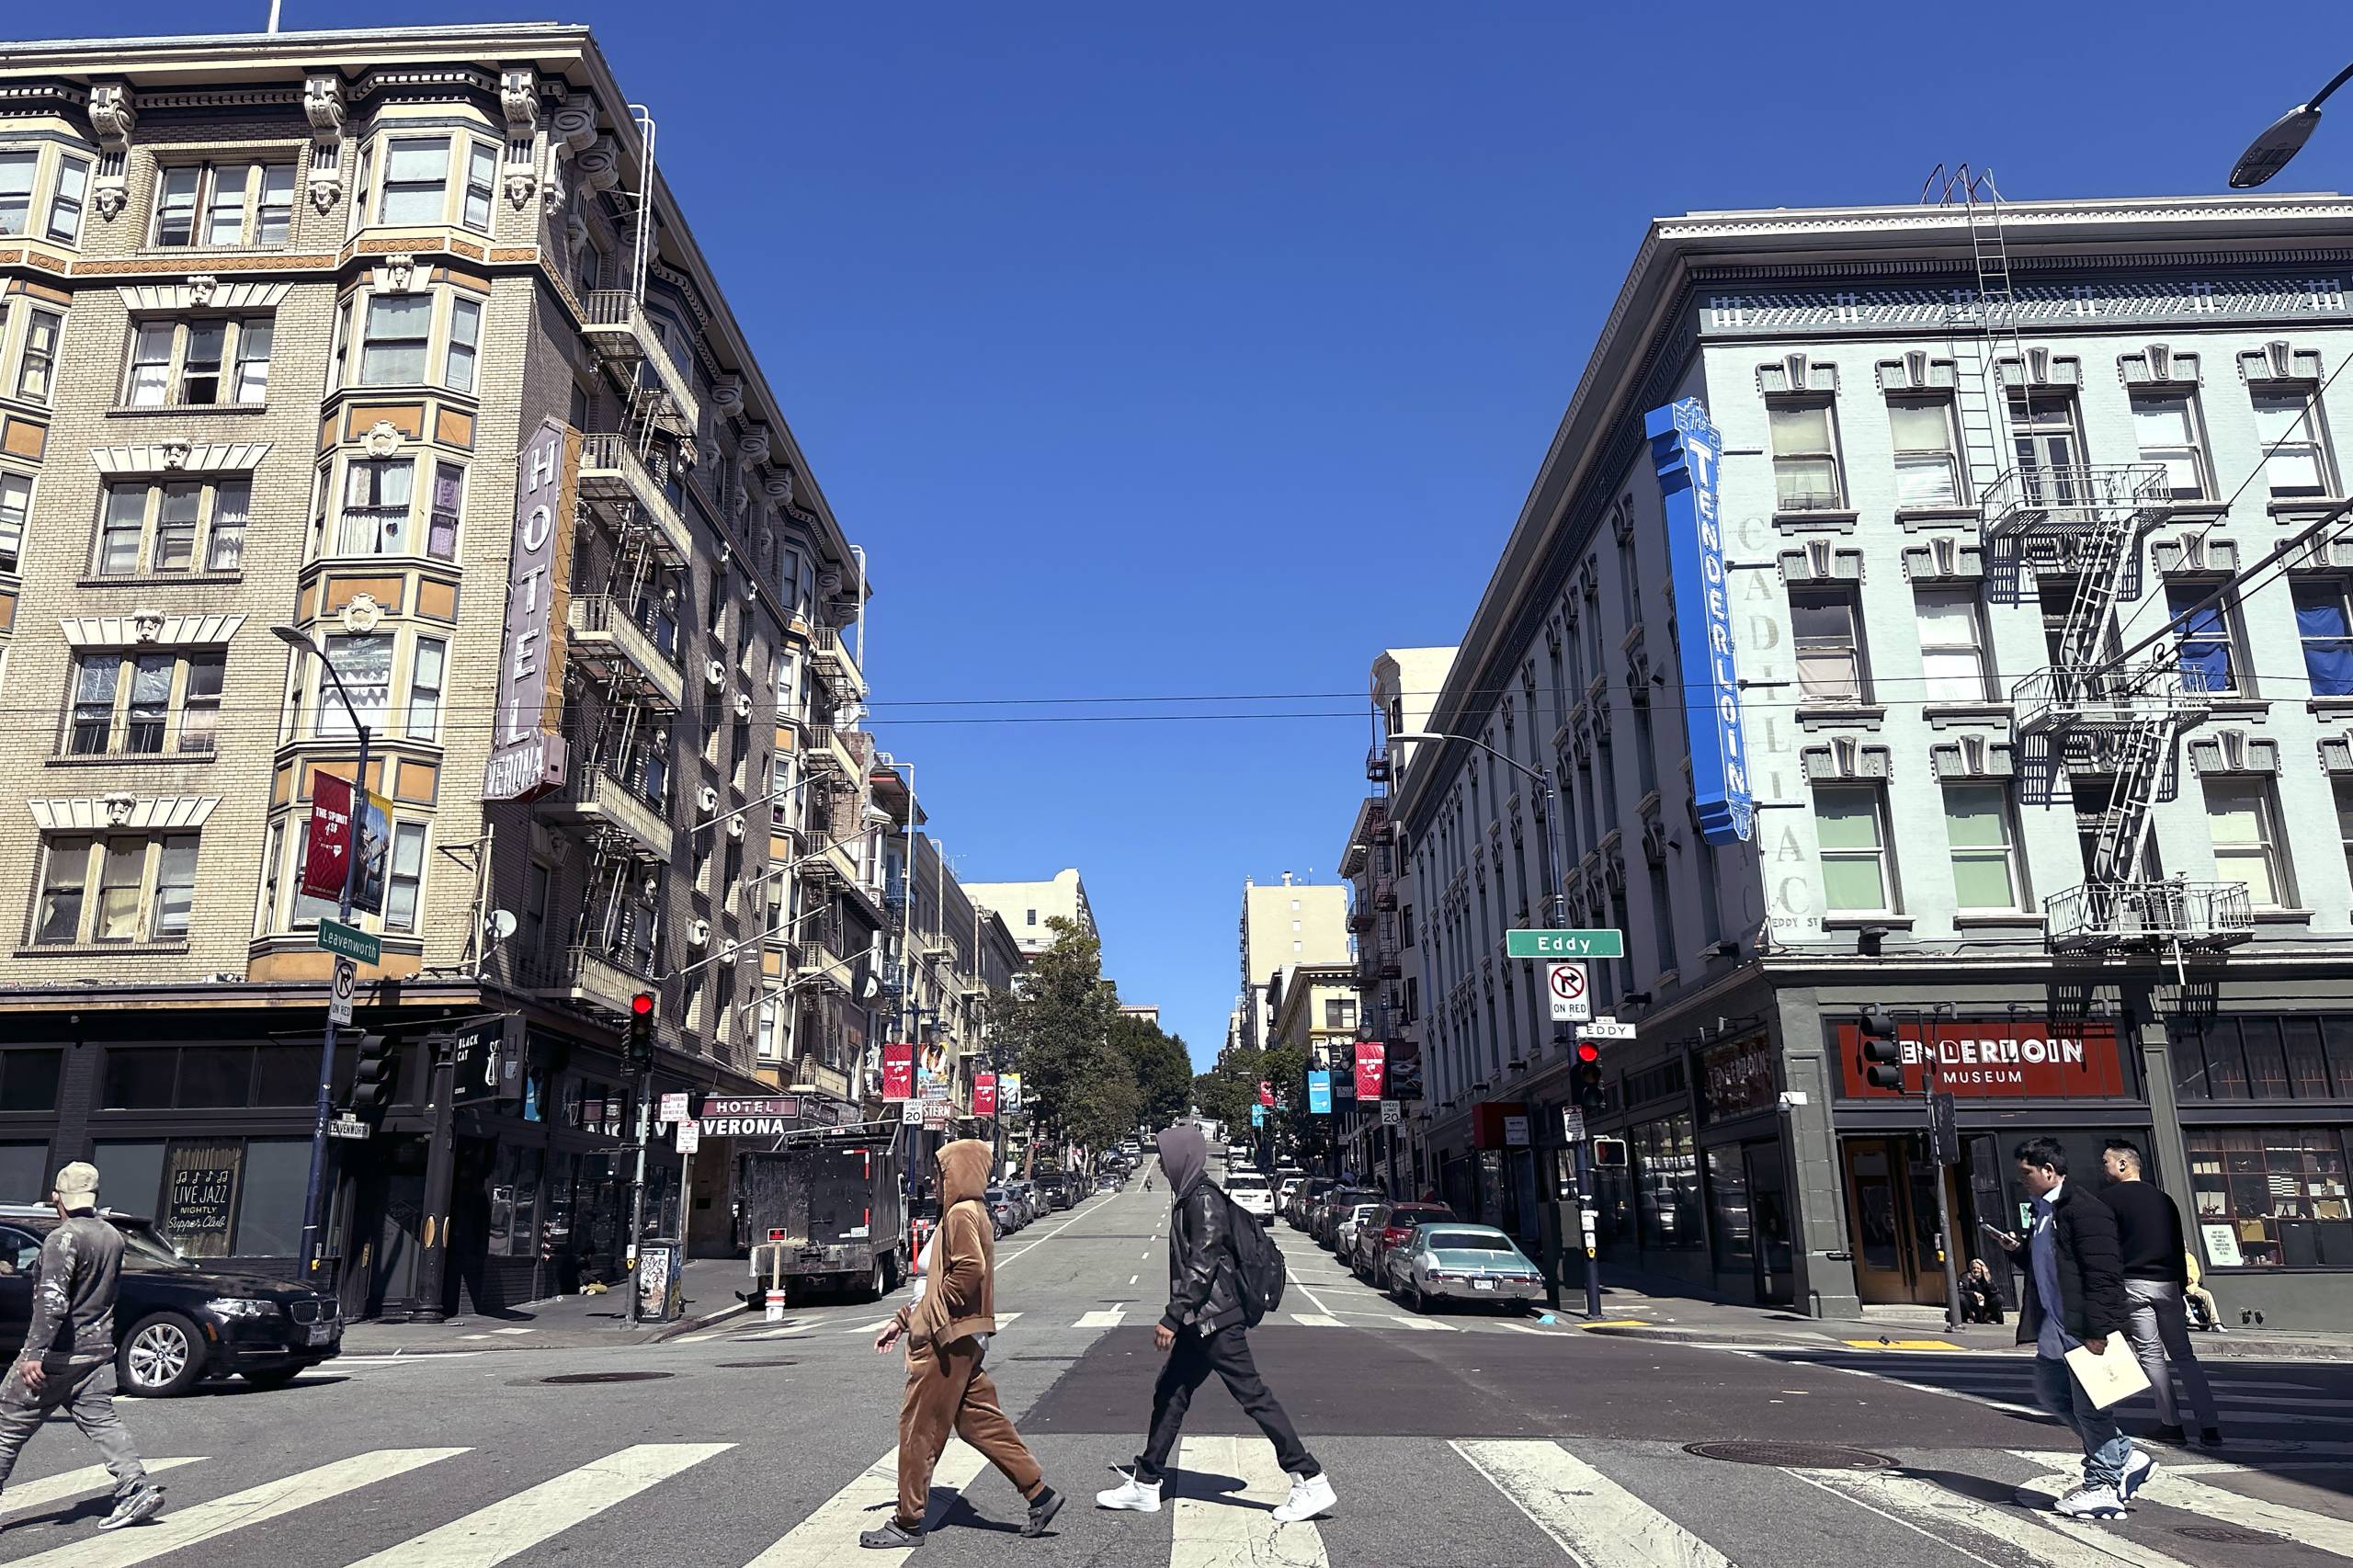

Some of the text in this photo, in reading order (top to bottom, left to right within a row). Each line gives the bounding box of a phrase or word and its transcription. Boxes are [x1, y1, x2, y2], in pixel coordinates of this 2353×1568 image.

[506, 439, 556, 745] HOTEL
[1688, 437, 1745, 795] TENDERLOIN
[487, 746, 544, 795] VERONA
[315, 806, 348, 825] THE SPIRIT
[1772, 917, 1818, 928] EDDY ST
[323, 926, 377, 959] Leavenworth
[1538, 937, 1591, 954] Eddy
[332, 1003, 350, 1017] ON RED
[1553, 1004, 1586, 1013] ON RED
[1587, 1026, 1626, 1036] EDDY
[458, 1034, 479, 1049] BLACK
[457, 1050, 469, 1062] CAT
[1899, 1039, 2083, 1064] ENDERLOIN
[1943, 1071, 2022, 1084] MUSEUM
[716, 1101, 774, 1114] HOTEL
[923, 1105, 951, 1118] STERN
[905, 1111, 921, 1121] 20
[1383, 1113, 1399, 1123] 20
[703, 1119, 785, 1135] VERONA
[174, 1185, 227, 1204] LIVE JAZZ
[180, 1206, 217, 1214] NIGHTLY
[168, 1215, 225, 1233] Supper Club
